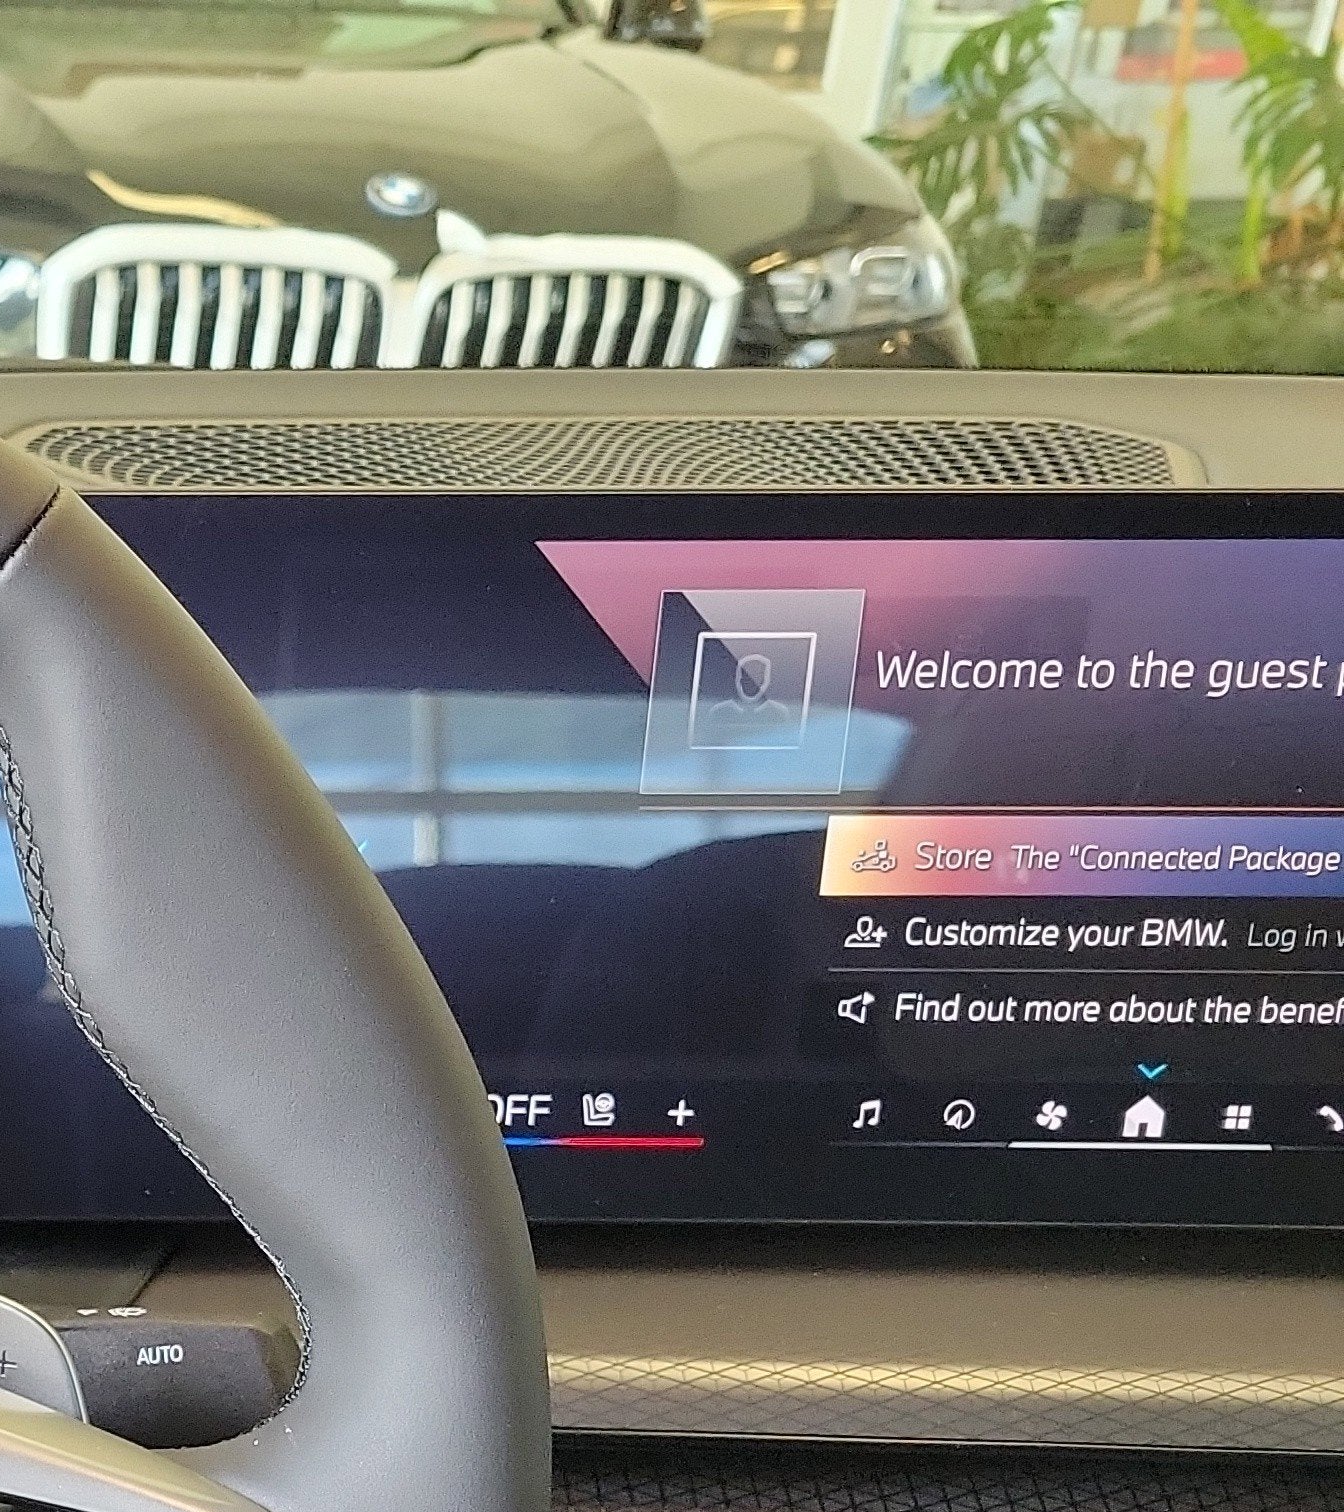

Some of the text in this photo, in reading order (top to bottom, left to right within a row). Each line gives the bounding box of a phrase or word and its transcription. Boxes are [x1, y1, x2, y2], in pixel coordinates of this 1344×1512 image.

[875, 649, 1064, 690] Welcome
[1076, 652, 1115, 689] to
[1129, 649, 1195, 690] the
[1205, 652, 1329, 698] guest
[913, 841, 1341, 876] Store The "Connected Package
[904, 916, 1059, 948] Customize
[1066, 924, 1134, 953] your
[1140, 917, 1228, 948] BMW.
[1247, 922, 1297, 953] Log
[1304, 923, 1328, 948] in
[894, 992, 1344, 1025] Find out more about the benef
[136, 1343, 184, 1366] AUTO
